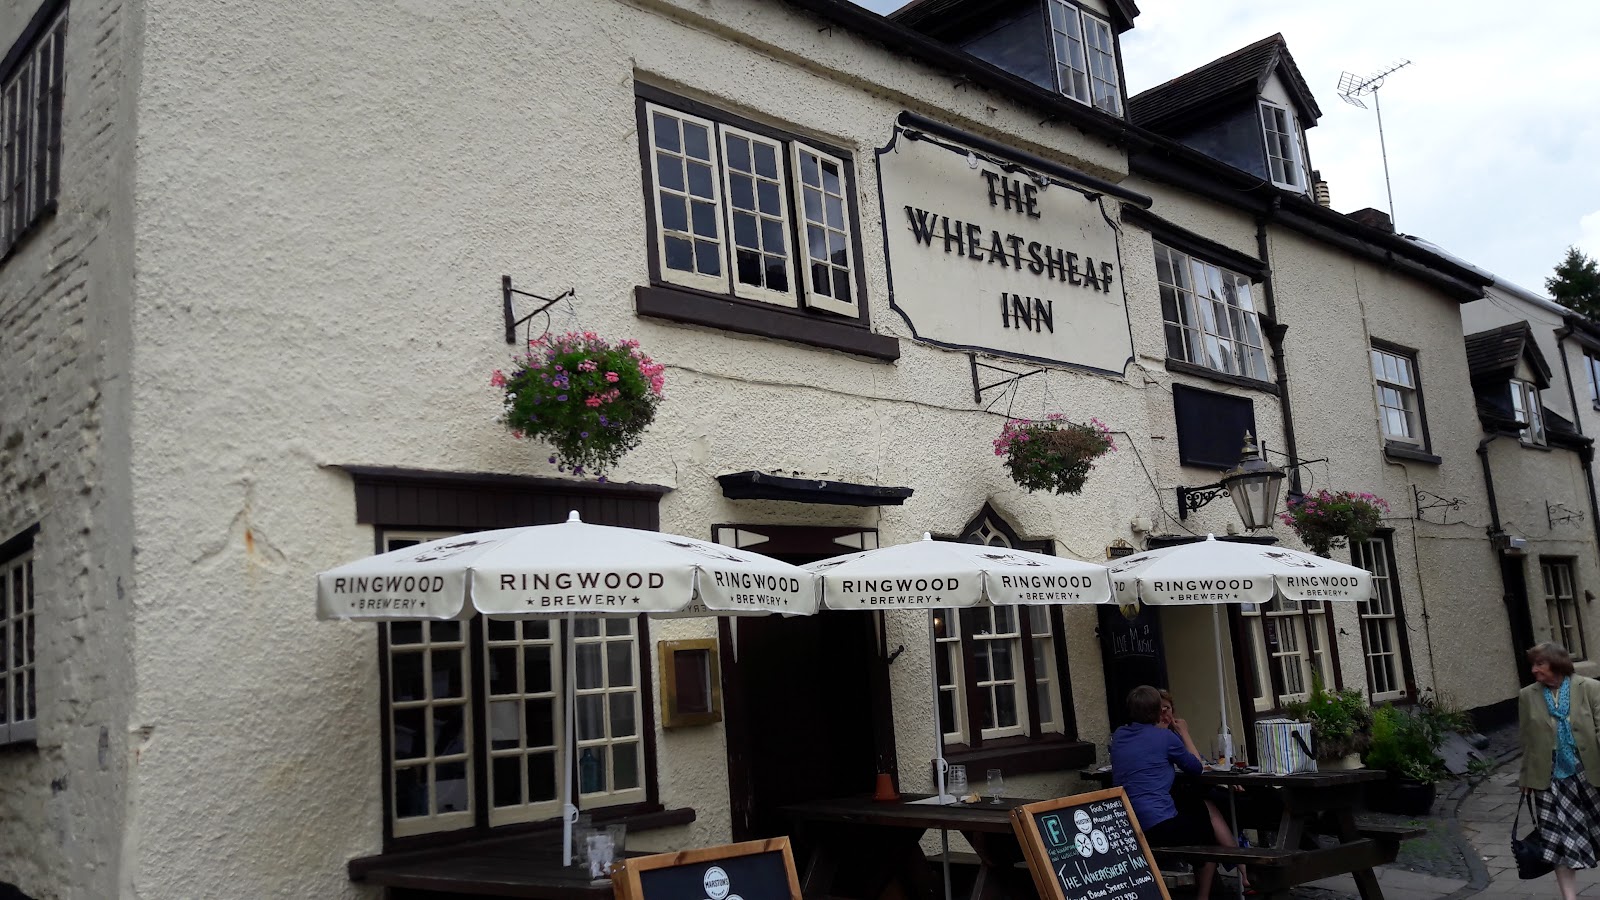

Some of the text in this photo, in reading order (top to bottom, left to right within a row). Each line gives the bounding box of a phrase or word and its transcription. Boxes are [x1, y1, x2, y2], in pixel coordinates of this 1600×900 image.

[981, 168, 1041, 219] THE
[904, 205, 1113, 293] WHEATSHEAF
[1002, 292, 1054, 334] INN
[335, 576, 444, 594] RINGWOOD
[500, 572, 664, 590] RINGWOOD
[714, 571, 799, 593] RINGWOOD
[842, 578, 959, 593] RINGWOOD
[1002, 575, 1092, 589] RINGWOOD
[1154, 579, 1253, 592] RINGWOOD
[1288, 576, 1358, 587] RINGWOOD
[1026, 592, 1073, 600] BREWERY
[1178, 593, 1230, 601] BREWERY
[1307, 589, 1342, 597] BREWERY
[359, 599, 417, 609] BREWERY
[541, 595, 627, 607] BREWERY
[736, 594, 781, 606] BREWERY
[870, 595, 932, 605] BREWERY
[1058, 854, 1148, 890] THE WHEATSHEAF INN
